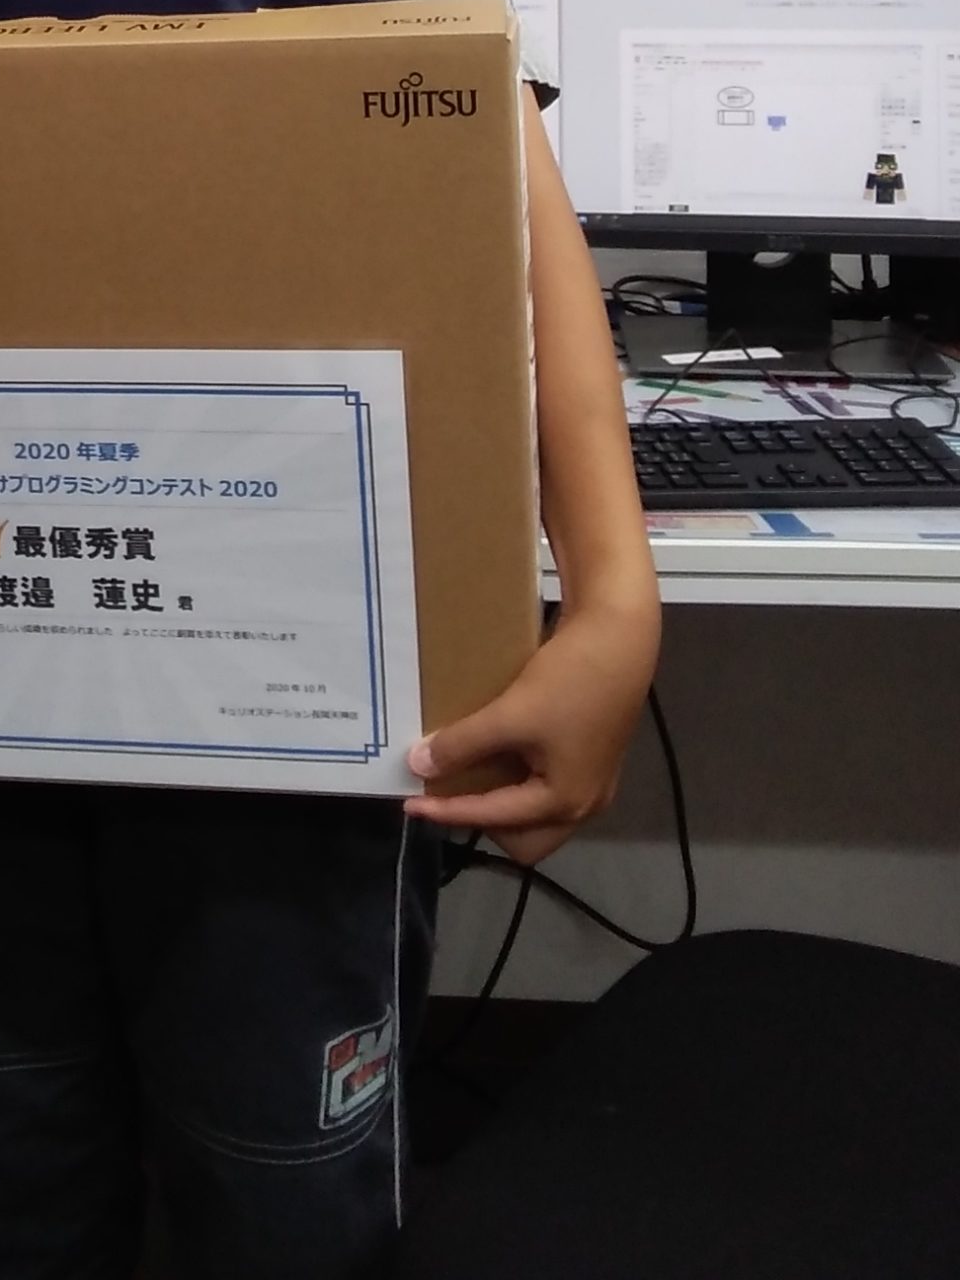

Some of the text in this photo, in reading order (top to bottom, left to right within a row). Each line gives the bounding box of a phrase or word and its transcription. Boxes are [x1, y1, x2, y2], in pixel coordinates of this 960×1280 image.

[362, 71, 477, 127] FUJITSU
[13, 441, 141, 463] 2020 年夏季
[219, 480, 279, 500] 2020
[12, 525, 157, 561] 最優秀賞
[91, 578, 165, 612] 蓮史
